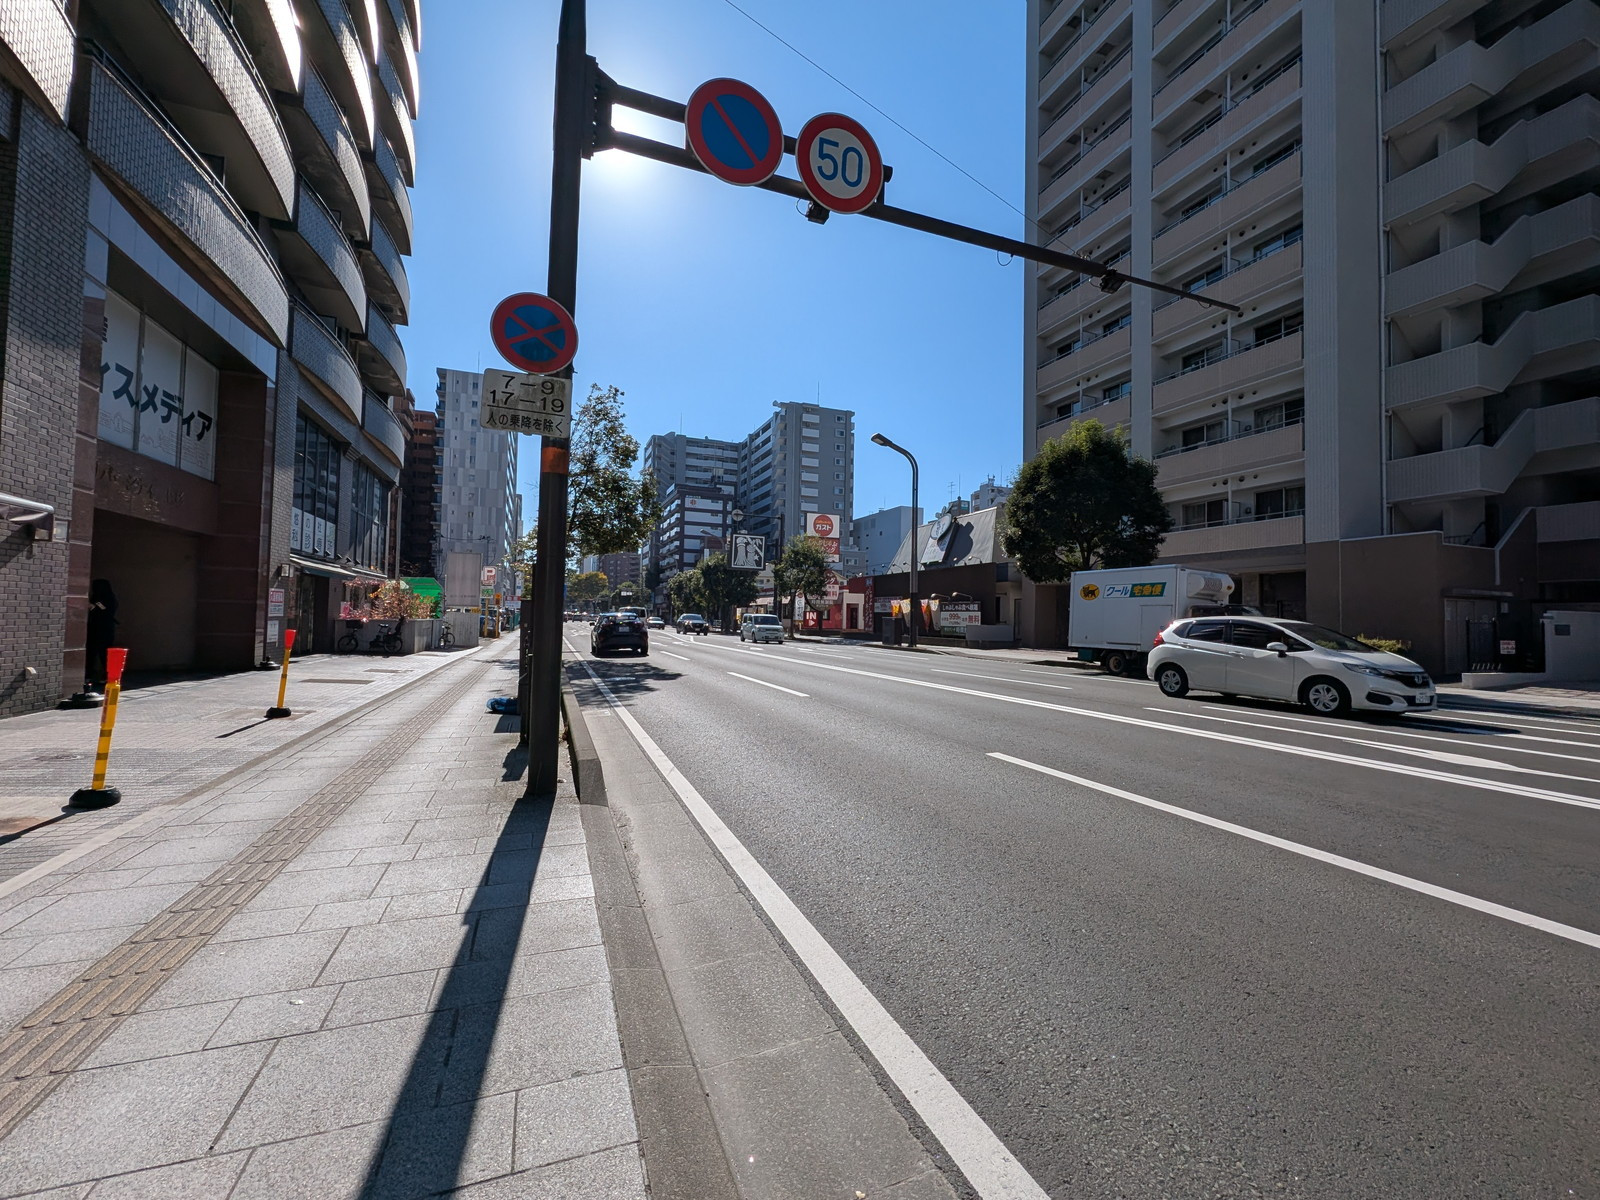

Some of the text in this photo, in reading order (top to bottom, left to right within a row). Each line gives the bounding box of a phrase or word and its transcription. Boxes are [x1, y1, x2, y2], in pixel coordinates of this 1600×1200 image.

[817, 136, 863, 188] 50
[486, 411, 563, 435] 人の乗降を除く
[484, 567, 496, 581] P
[1106, 584, 1163, 597] クール宅急便
[806, 611, 817, 620] IN
